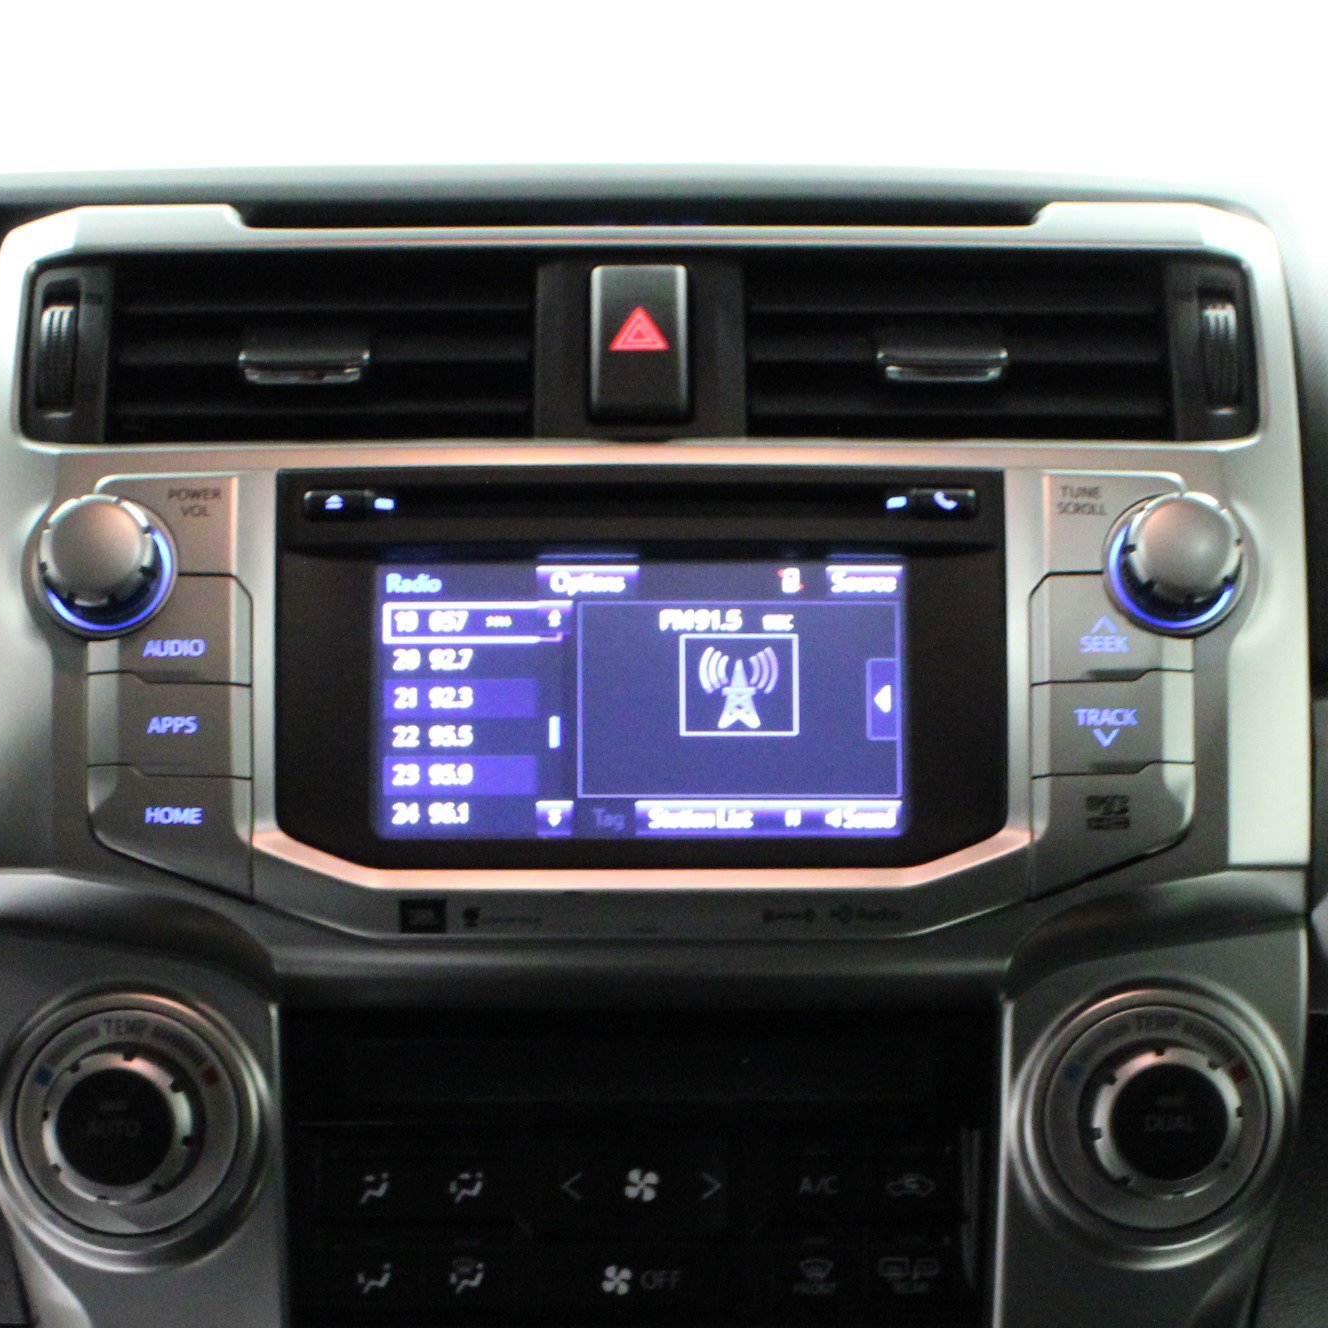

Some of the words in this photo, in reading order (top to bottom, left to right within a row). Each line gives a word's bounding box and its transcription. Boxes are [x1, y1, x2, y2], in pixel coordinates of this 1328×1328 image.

[168, 487, 221, 501] POWER
[1060, 485, 1102, 499] TUNE
[180, 504, 211, 517] VOL
[1057, 501, 1106, 516] SCROLL
[385, 573, 442, 593] Radio
[550, 571, 625, 596] Options
[830, 571, 897, 592] Source
[659, 608, 743, 631] FM91.5
[142, 639, 207, 658] AUDIO
[1079, 635, 1130, 653] SEEK
[428, 648, 473, 671] 92.7
[394, 686, 418, 709] 21
[428, 686, 473, 709] 92.3
[147, 716, 199, 734] APPS
[1074, 708, 1138, 727] TRACK
[392, 725, 420, 748] 22
[428, 725, 473, 747] 95.5
[392, 763, 420, 786] 23
[145, 807, 203, 825] HOME
[392, 802, 420, 824] 24
[648, 806, 716, 829] Station
[716, 808, 754, 829] List
[842, 807, 897, 829] Sound
[798, 1176, 838, 1195] A/C
[640, 1270, 681, 1290] OFF
